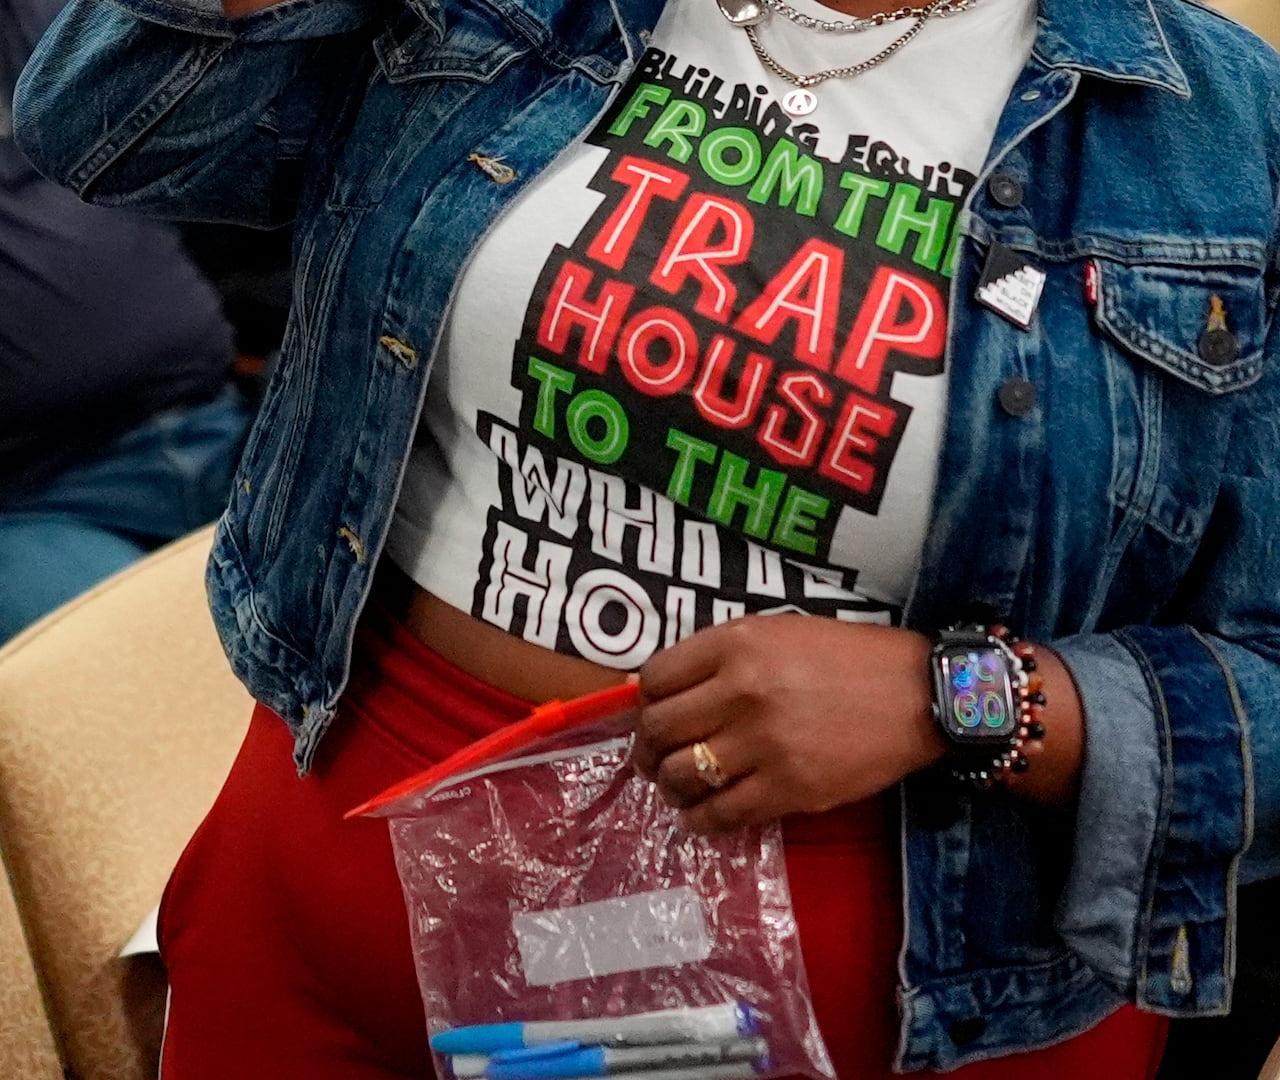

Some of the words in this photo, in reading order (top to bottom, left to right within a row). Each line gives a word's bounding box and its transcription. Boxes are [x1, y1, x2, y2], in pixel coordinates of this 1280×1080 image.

[607, 82, 824, 217] FROM
[537, 258, 898, 495] HOUSE
[585, 155, 949, 395] TRAP
[527, 355, 630, 466] TO
[665, 427, 831, 556] THE
